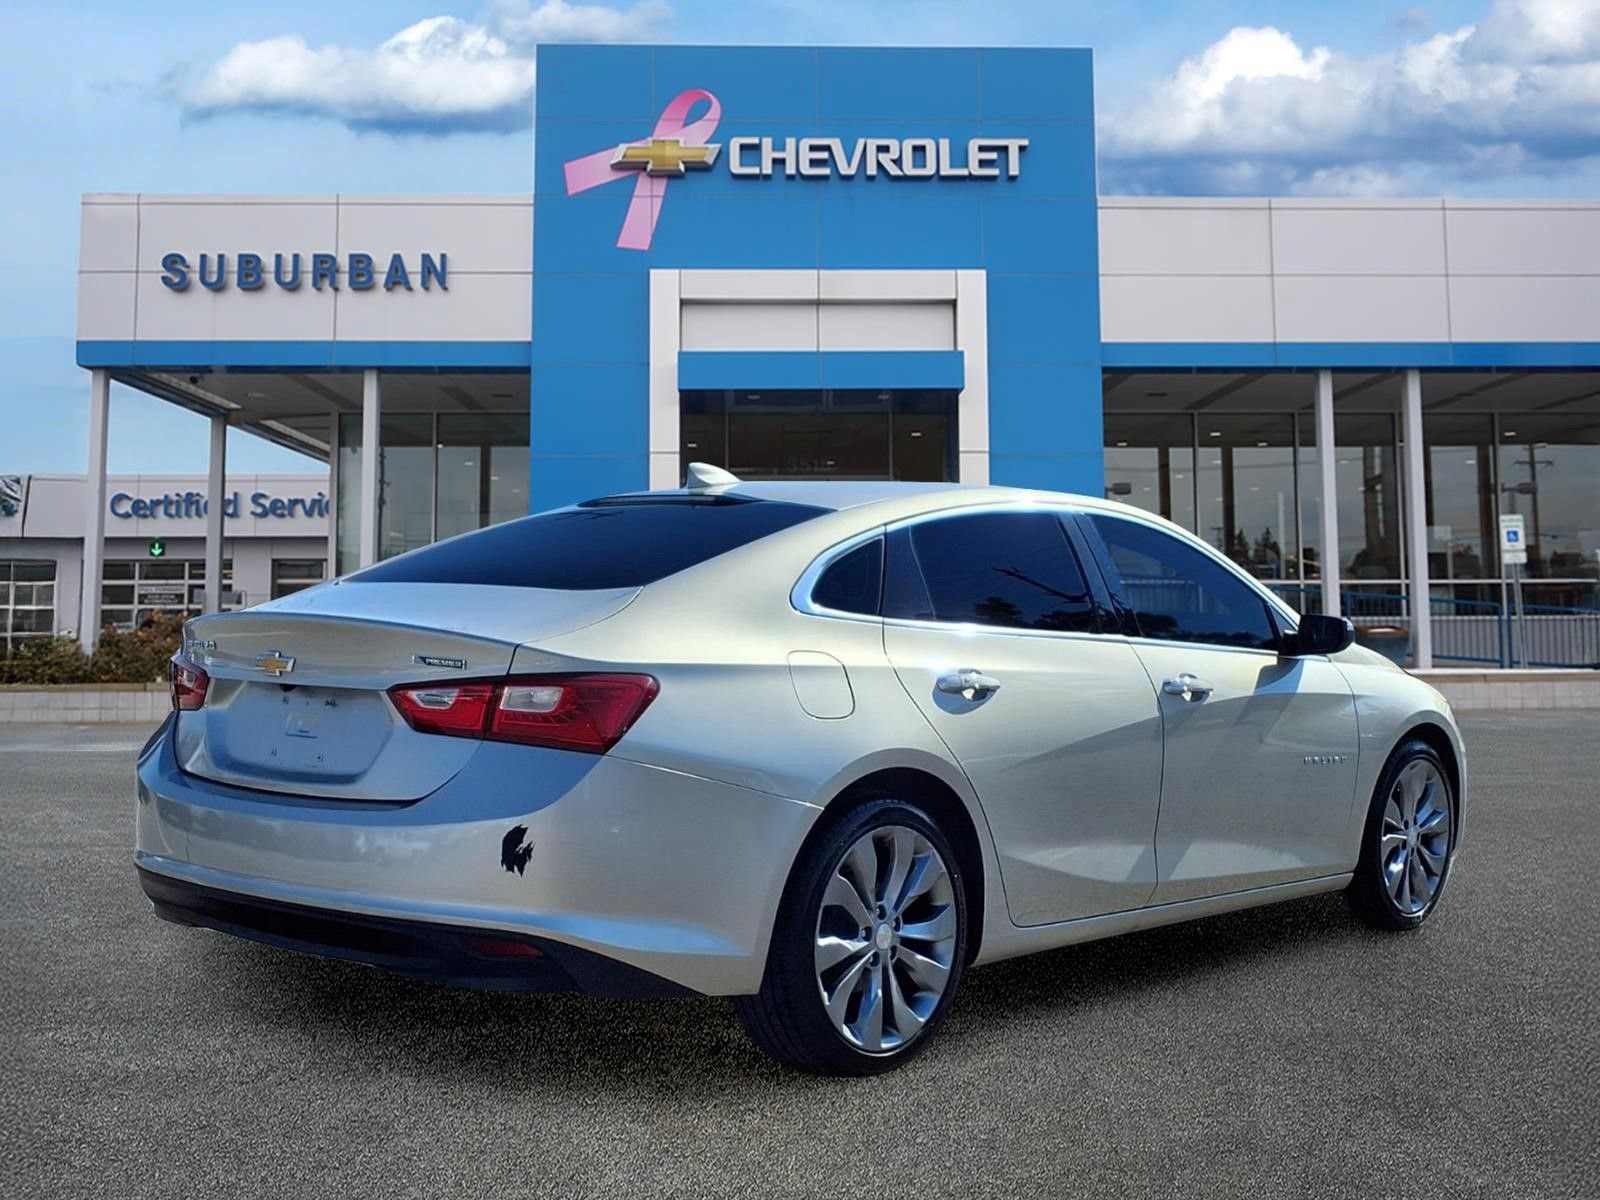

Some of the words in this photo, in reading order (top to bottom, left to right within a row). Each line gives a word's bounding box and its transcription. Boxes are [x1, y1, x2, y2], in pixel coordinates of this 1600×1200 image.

[729, 136, 1029, 177] CHEVROLET
[161, 252, 449, 292] SUBURBAN
[110, 492, 240, 519] Certifid
[250, 491, 330, 519] Servi
